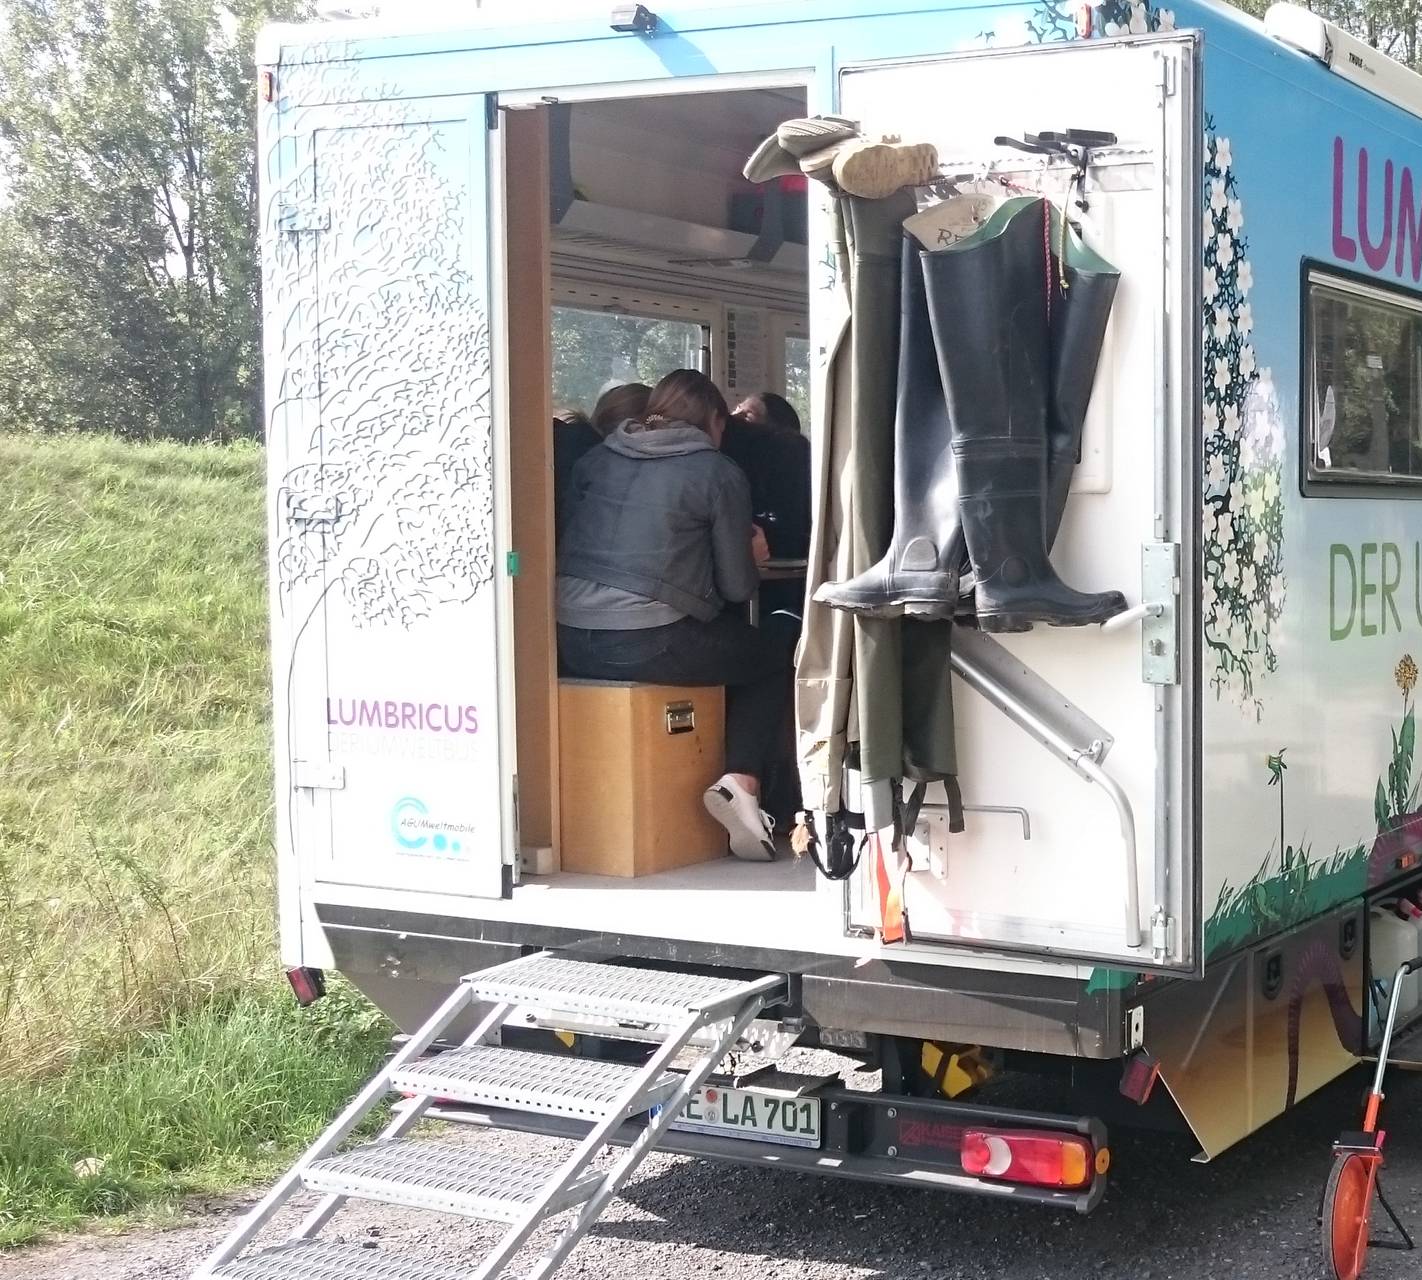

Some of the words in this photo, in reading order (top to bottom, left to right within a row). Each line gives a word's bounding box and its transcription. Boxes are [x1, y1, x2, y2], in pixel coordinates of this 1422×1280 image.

[1330, 542, 1402, 641] DER
[327, 697, 478, 734] LUMBRICUS
[679, 1090, 703, 1121] E
[722, 1093, 757, 1127] LA
[764, 1099, 816, 1135] 701
